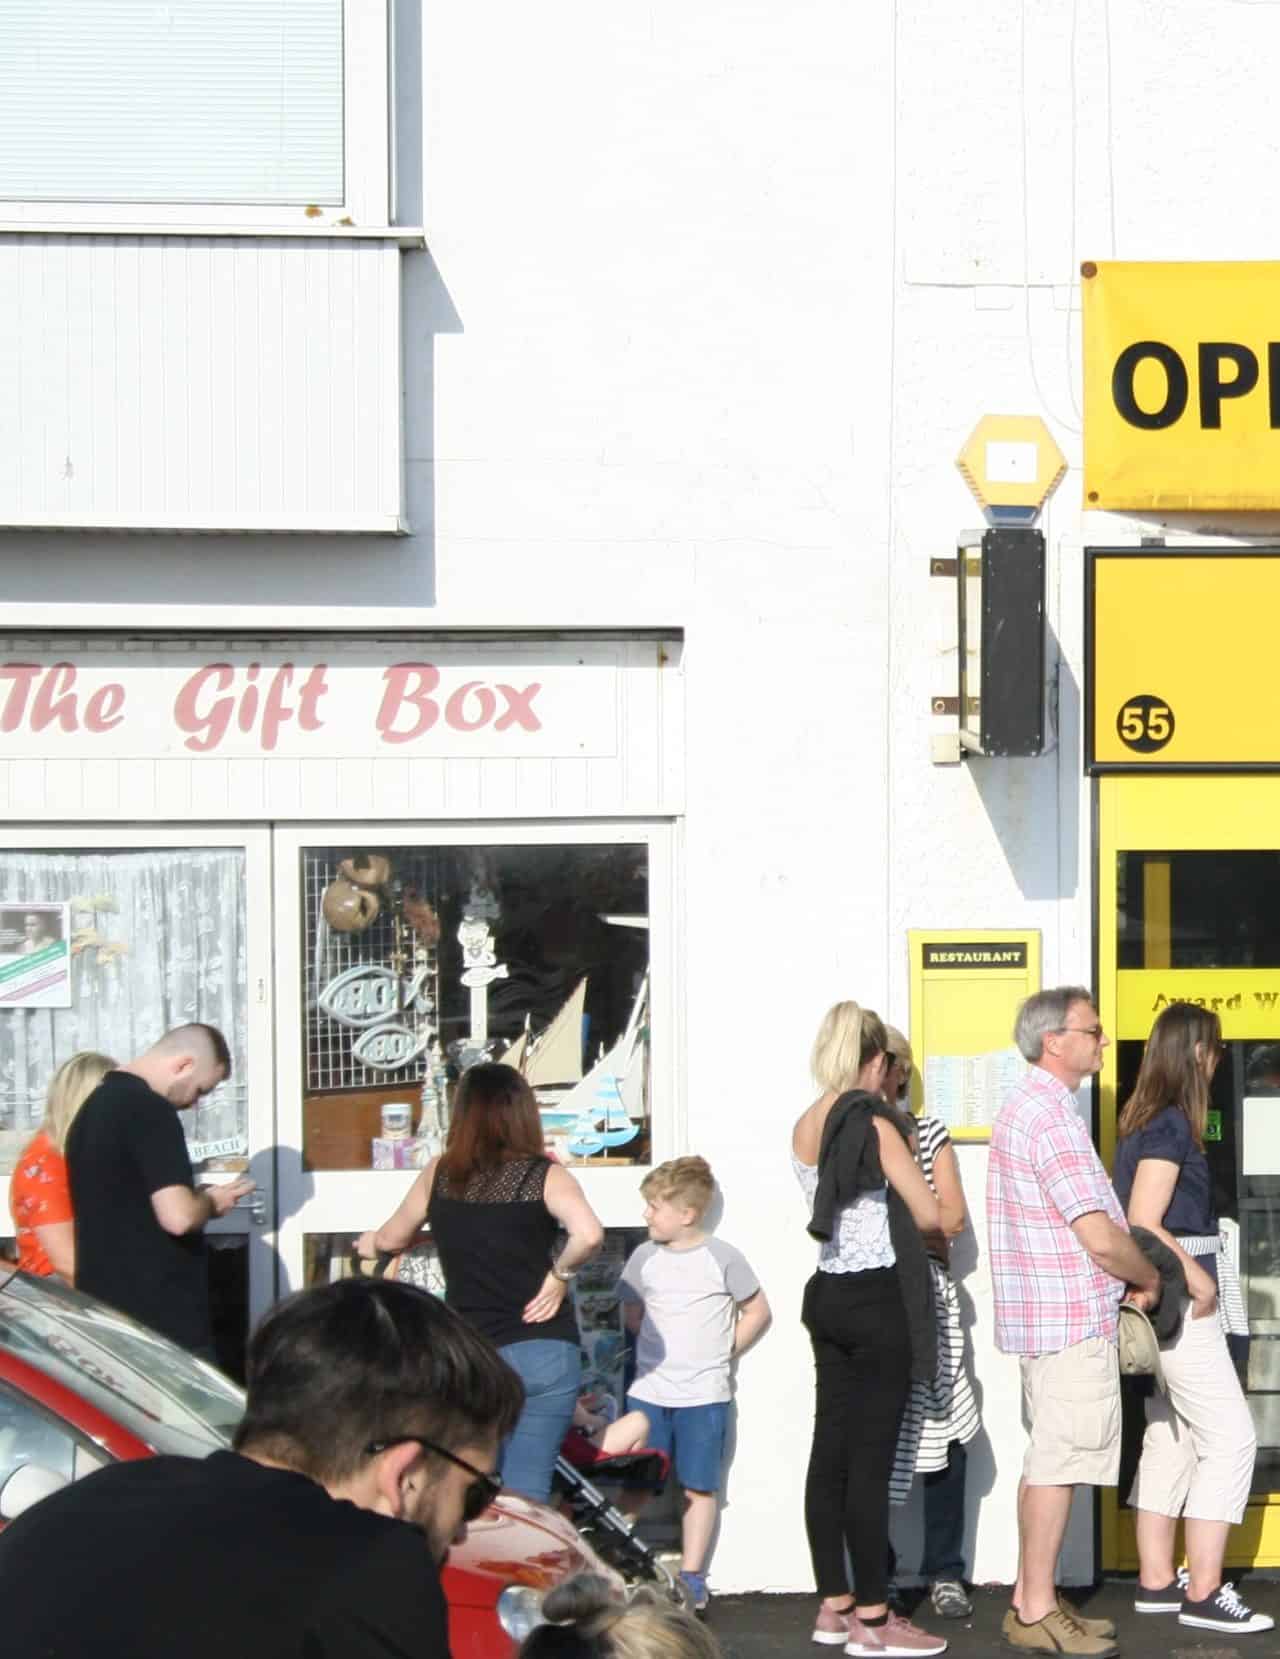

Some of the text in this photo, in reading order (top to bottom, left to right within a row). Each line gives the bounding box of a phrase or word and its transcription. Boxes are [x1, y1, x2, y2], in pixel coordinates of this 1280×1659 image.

[0, 661, 542, 752] The Gift Box
[1121, 707, 1170, 740] 55
[929, 951, 1022, 963] RESTAURANT
